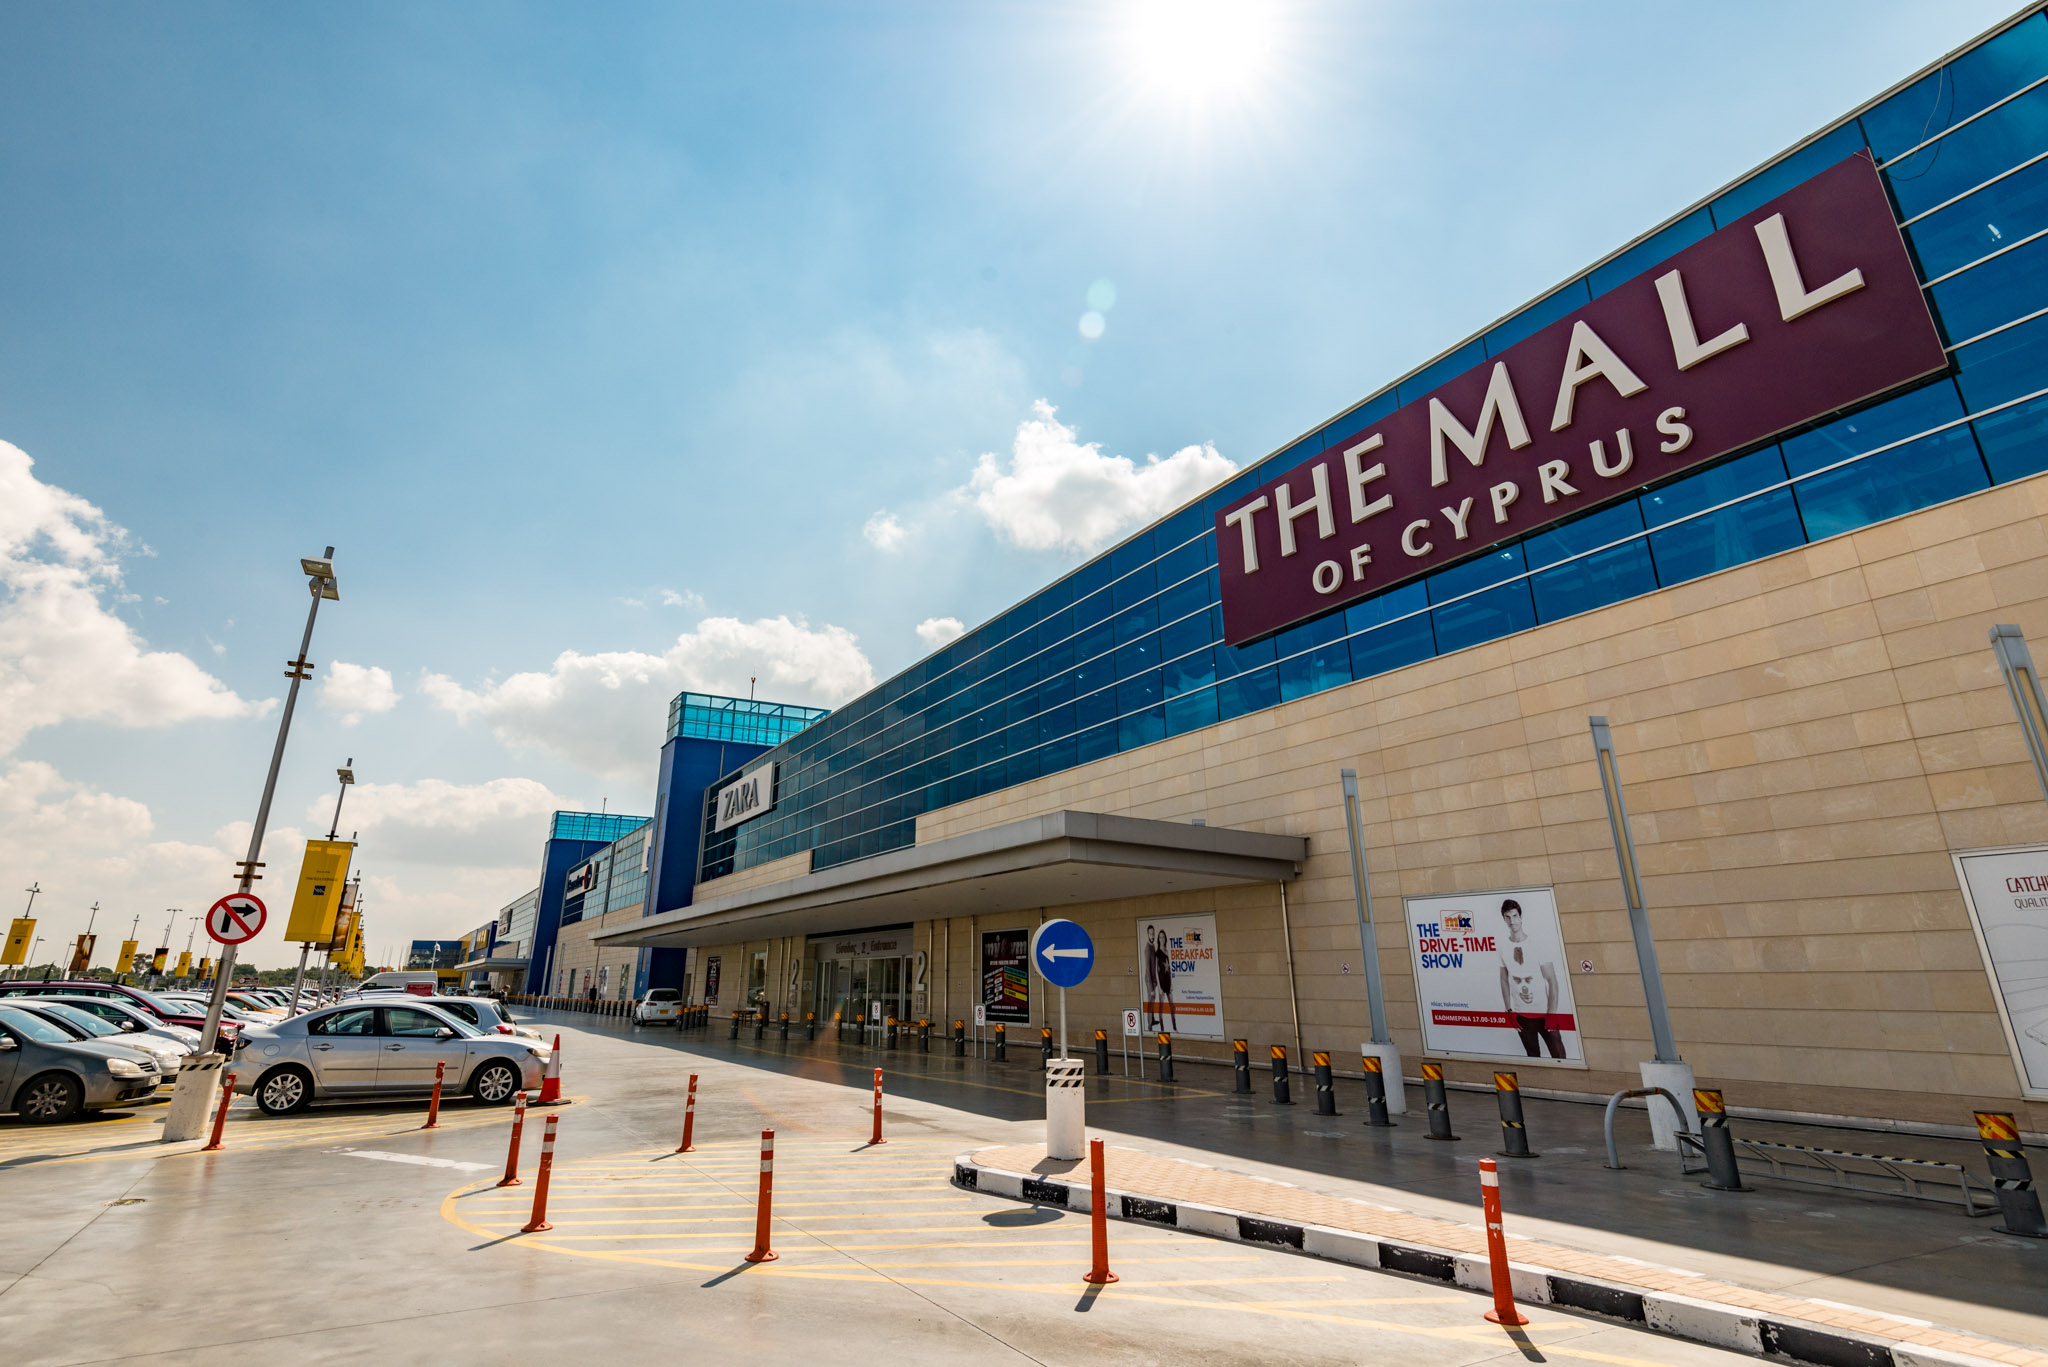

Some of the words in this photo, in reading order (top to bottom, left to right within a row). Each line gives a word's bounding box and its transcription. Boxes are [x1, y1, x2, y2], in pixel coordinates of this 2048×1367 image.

[1225, 433, 1394, 575] THE
[1429, 212, 1866, 488] MALL
[1311, 543, 1373, 594] OF
[1401, 406, 1695, 557] CYPRUS
[723, 778, 759, 821] ZARA
[1444, 914, 1472, 928] mix
[1416, 923, 1440, 937] THE
[1169, 937, 1183, 948] THE
[1419, 936, 1496, 953] DRIVE-TIME
[1170, 948, 1213, 960] BREAKFAST
[1421, 953, 1463, 968] SHOW
[790, 959, 798, 989] 2
[915, 951, 926, 991] 2
[1171, 961, 1195, 972] SHOW
